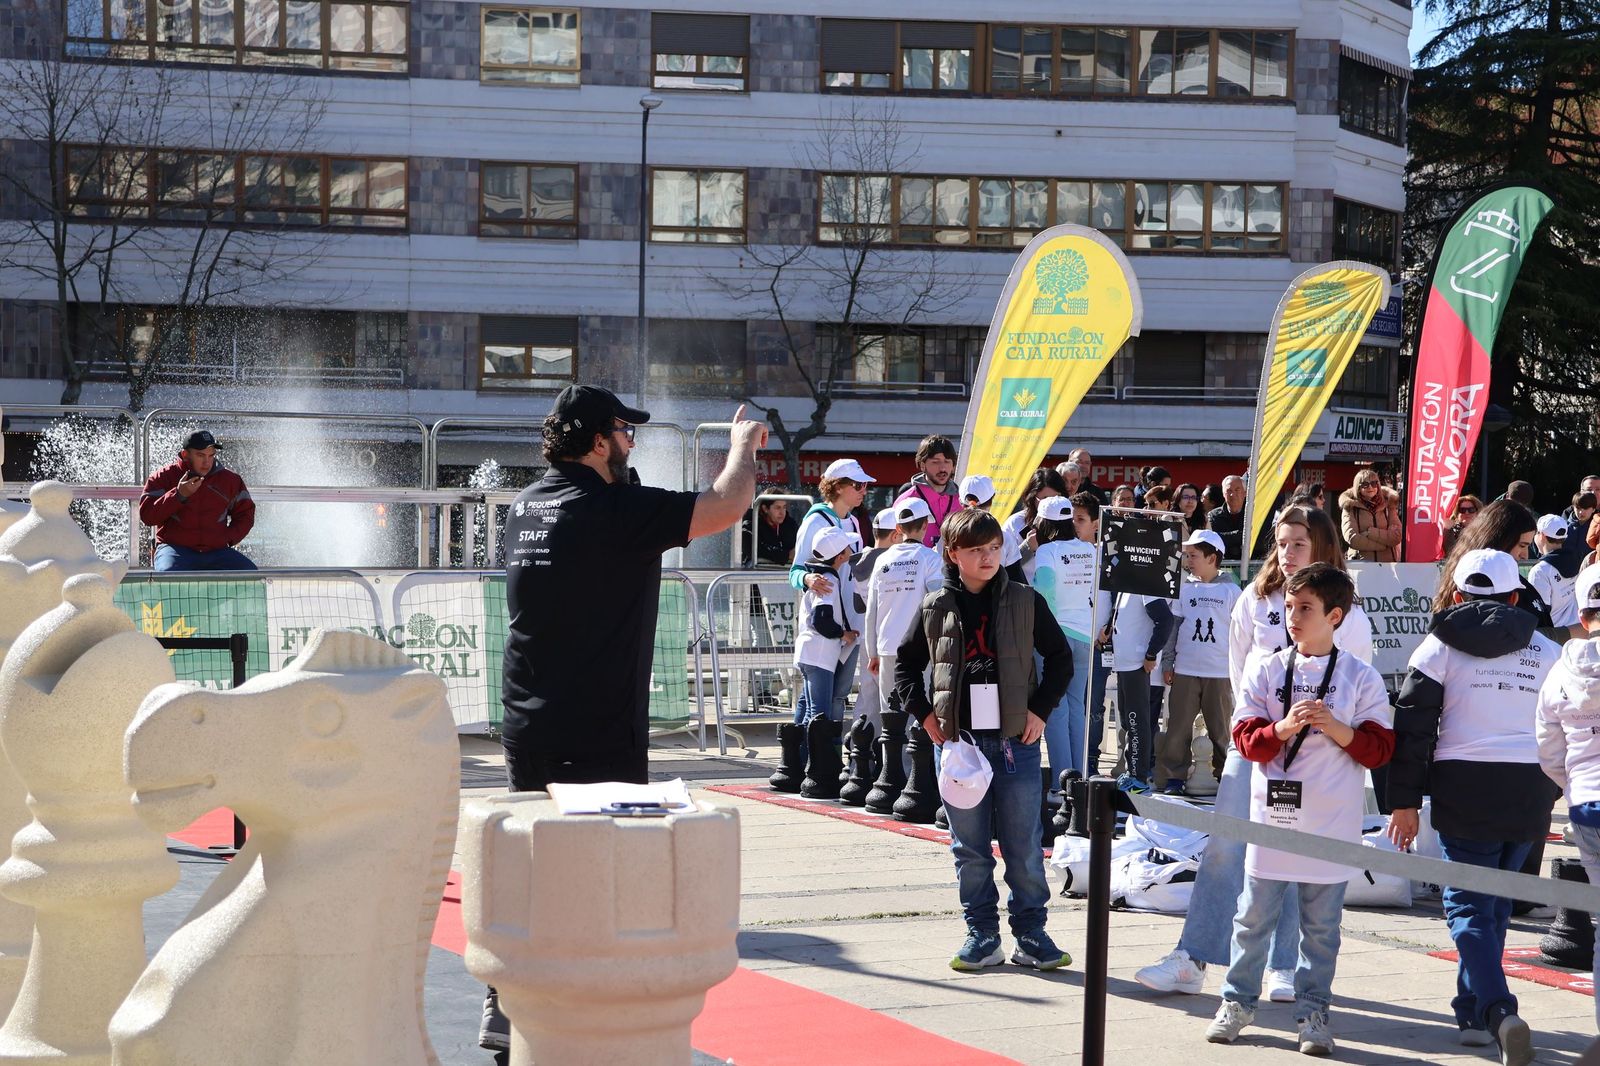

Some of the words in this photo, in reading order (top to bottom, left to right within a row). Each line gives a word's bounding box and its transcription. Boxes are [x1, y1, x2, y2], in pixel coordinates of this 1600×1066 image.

[1006, 346, 1043, 360] CAJA
[1048, 346, 1101, 360] RURAL
[1000, 410, 1018, 418] CAJA
[1020, 410, 1045, 418] RURAL
[1334, 416, 1385, 441] ADINCO
[527, 499, 561, 509] PEQUEÑO
[525, 509, 560, 517] GIGANTE
[542, 516, 558, 524] 2026
[518, 530, 549, 542] STAFF
[1123, 545, 1136, 553] SAN
[1135, 546, 1161, 556] VICENTE
[1519, 658, 1541, 669] 2026
[1475, 668, 1516, 677] fundación
[1128, 711, 1137, 735] Calvin
